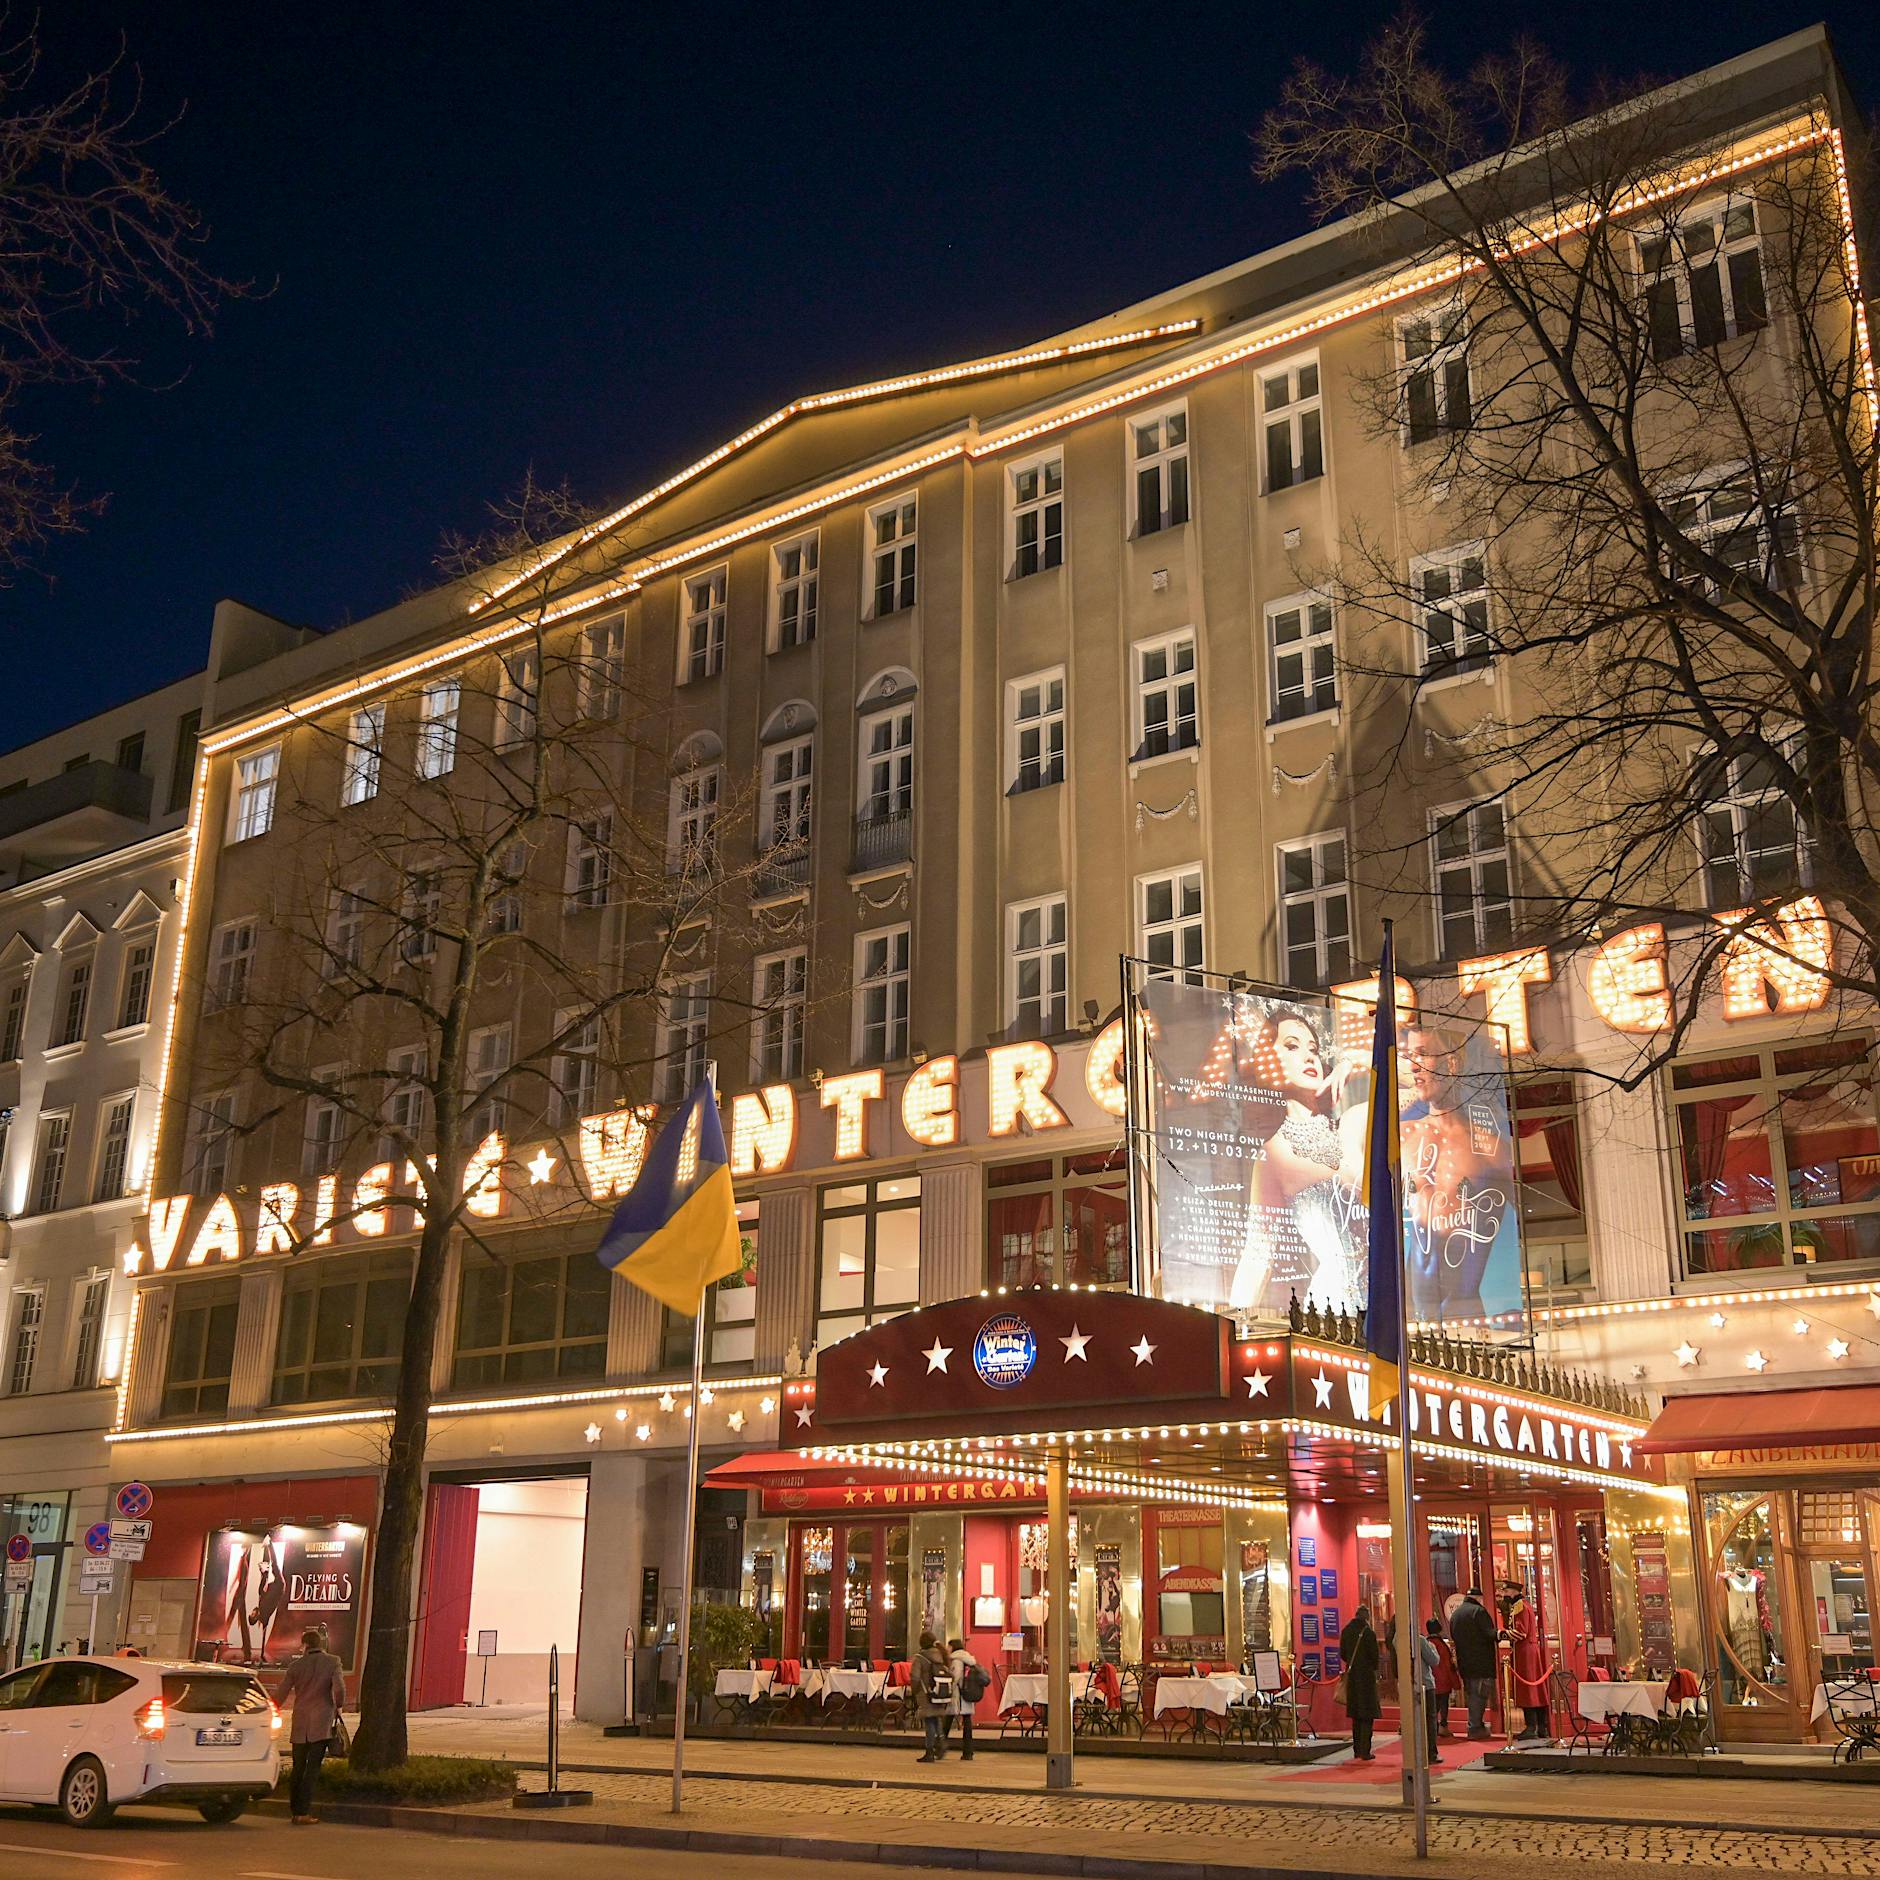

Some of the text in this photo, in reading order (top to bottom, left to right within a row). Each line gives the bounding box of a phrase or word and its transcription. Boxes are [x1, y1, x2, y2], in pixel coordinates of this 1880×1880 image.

[1179, 1078, 1283, 1098] SHEILA WOLF PRÄSENTIERT
[1473, 1119, 1493, 1127] SHOW
[1169, 1126, 1265, 1146] TWO NIGHTS ONLY
[1168, 1137, 1267, 1161] 12.+13.03.22
[1194, 1183, 1244, 1194] featuring
[1183, 1197, 1205, 1205] ELIZA
[1209, 1208, 1240, 1219] DEVILLE
[1187, 1224, 1237, 1237] CHAMPAGNE
[983, 1334, 1026, 1352] Winter
[884, 1481, 1093, 1503] WINTERGAR
[28, 1502, 51, 1534] 98
[1158, 1508, 1221, 1523] THEATERKASSE
[308, 1573, 337, 1583] FLYING
